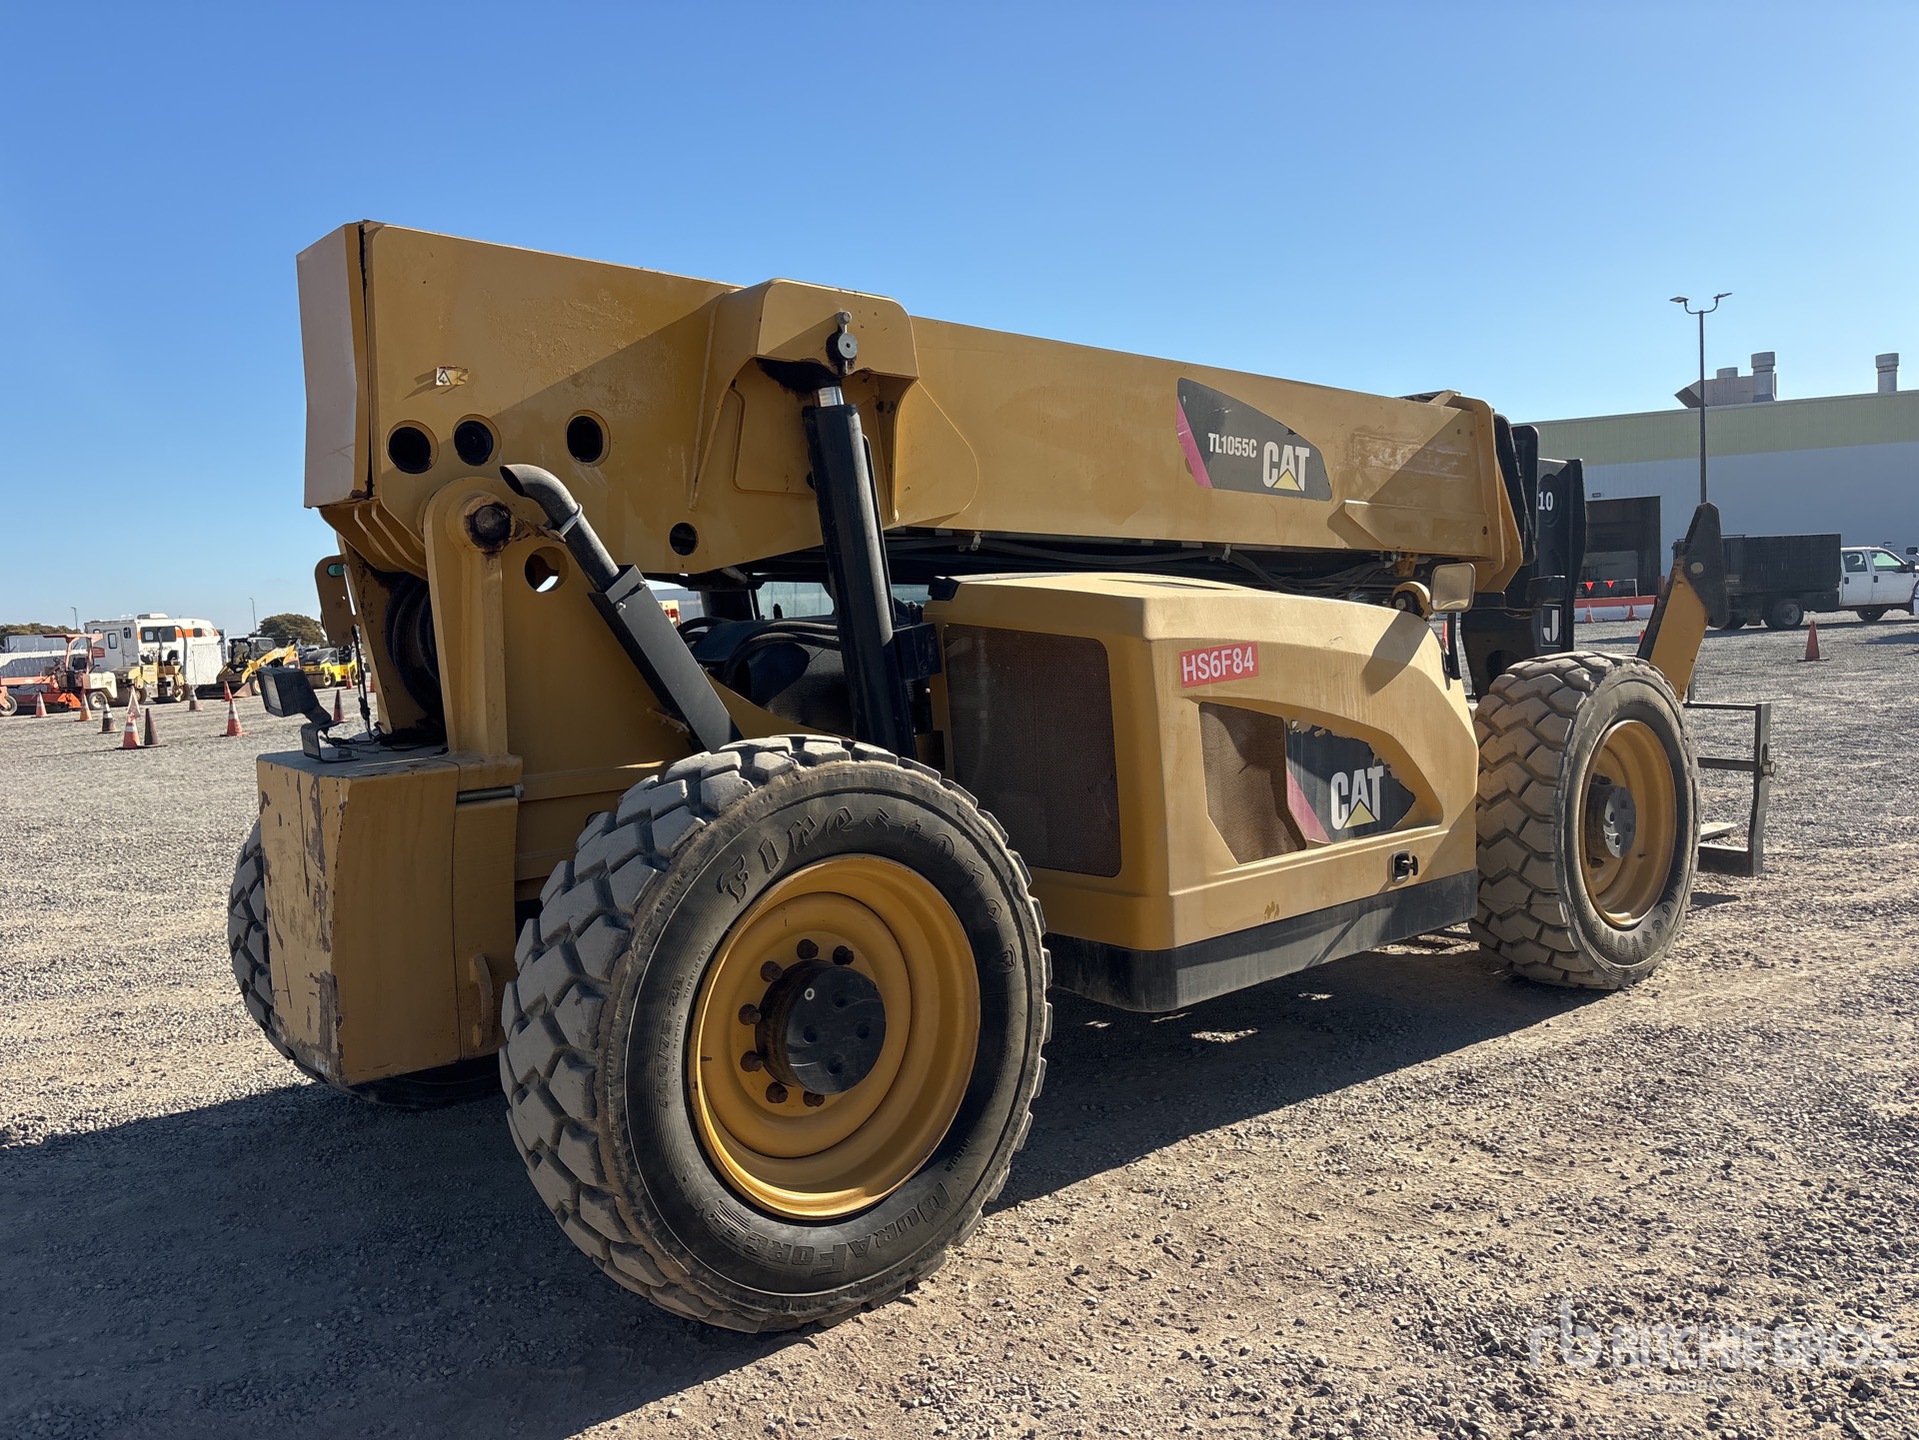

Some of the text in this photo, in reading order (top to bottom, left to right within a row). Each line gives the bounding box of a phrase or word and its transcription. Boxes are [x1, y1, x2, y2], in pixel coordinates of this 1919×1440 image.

[1208, 432, 1257, 459] TL1055C
[1262, 441, 1310, 492] CAT
[1538, 491, 1554, 512] 10
[1181, 645, 1255, 683] HS6F84
[1330, 765, 1385, 831] CAT
